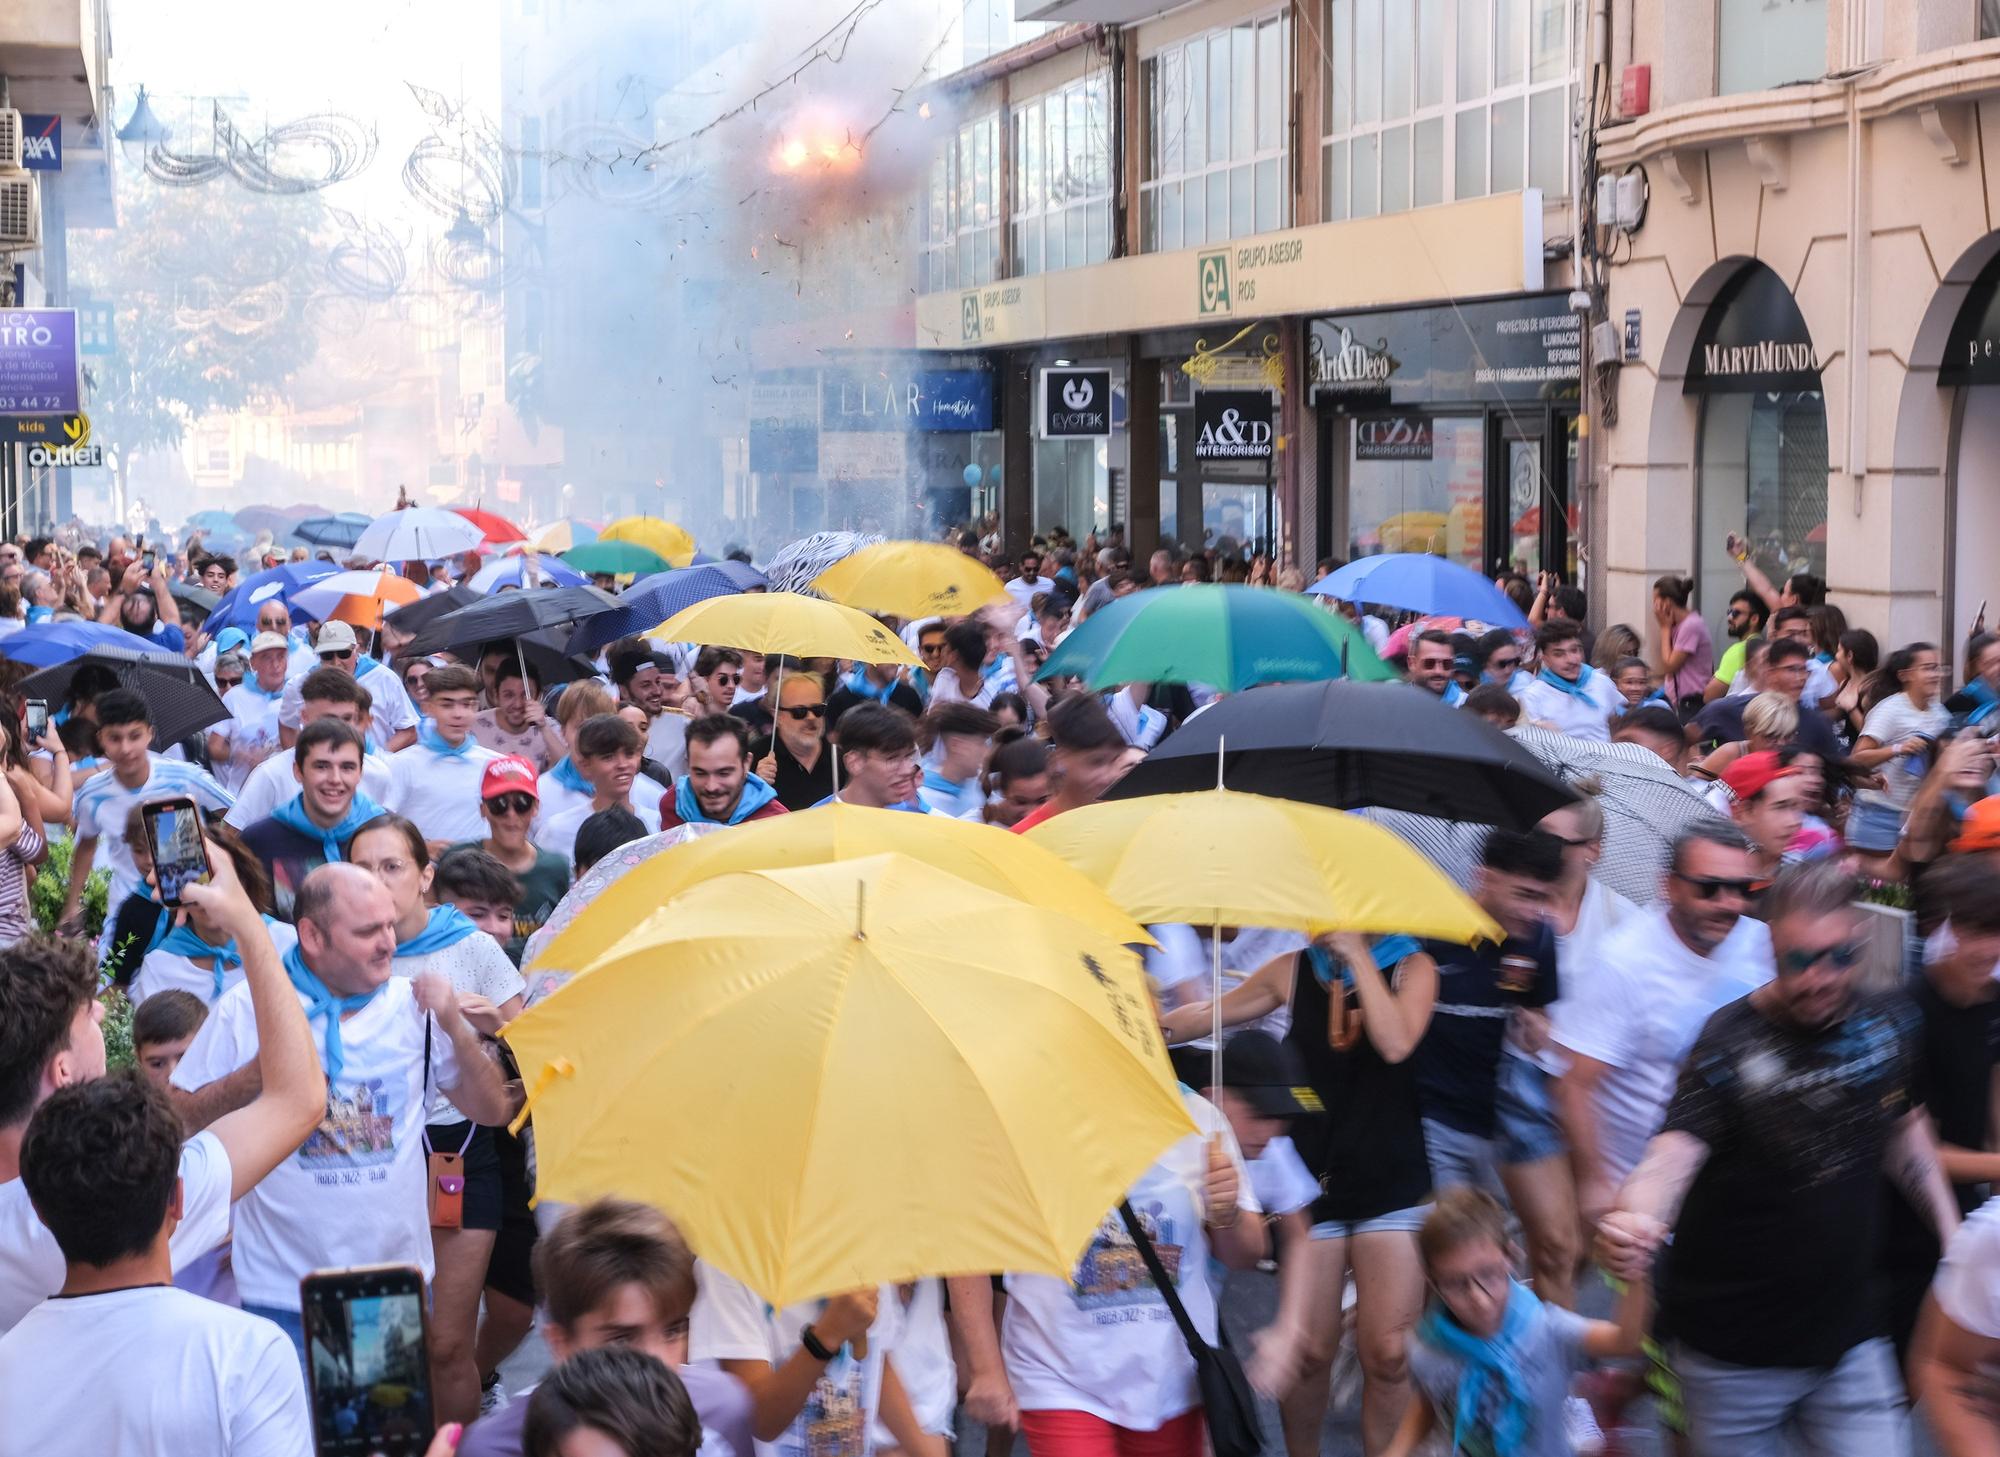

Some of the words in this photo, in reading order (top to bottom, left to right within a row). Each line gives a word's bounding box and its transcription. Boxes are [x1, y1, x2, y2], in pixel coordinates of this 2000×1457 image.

[22, 136, 57, 160] AXA
[1238, 245, 1266, 269] GRUPO
[1268, 239, 1303, 265] ASESOR
[1238, 279, 1256, 301] ROS
[1496, 318, 1530, 334] PROYECTOS
[1530, 317, 1538, 332] DE
[1539, 314, 1581, 331] INTERIORISMO
[1, 326, 52, 346] TRO
[1547, 347, 1581, 363] REFORMAS
[21, 397, 38, 409] 44
[44, 396, 61, 408] 72
[841, 382, 921, 417] LLAR
[18, 421, 46, 434] kids
[1196, 408, 1272, 446] A&D
[29, 444, 101, 467] outlet
[1195, 444, 1272, 457] INTERIORISMO
